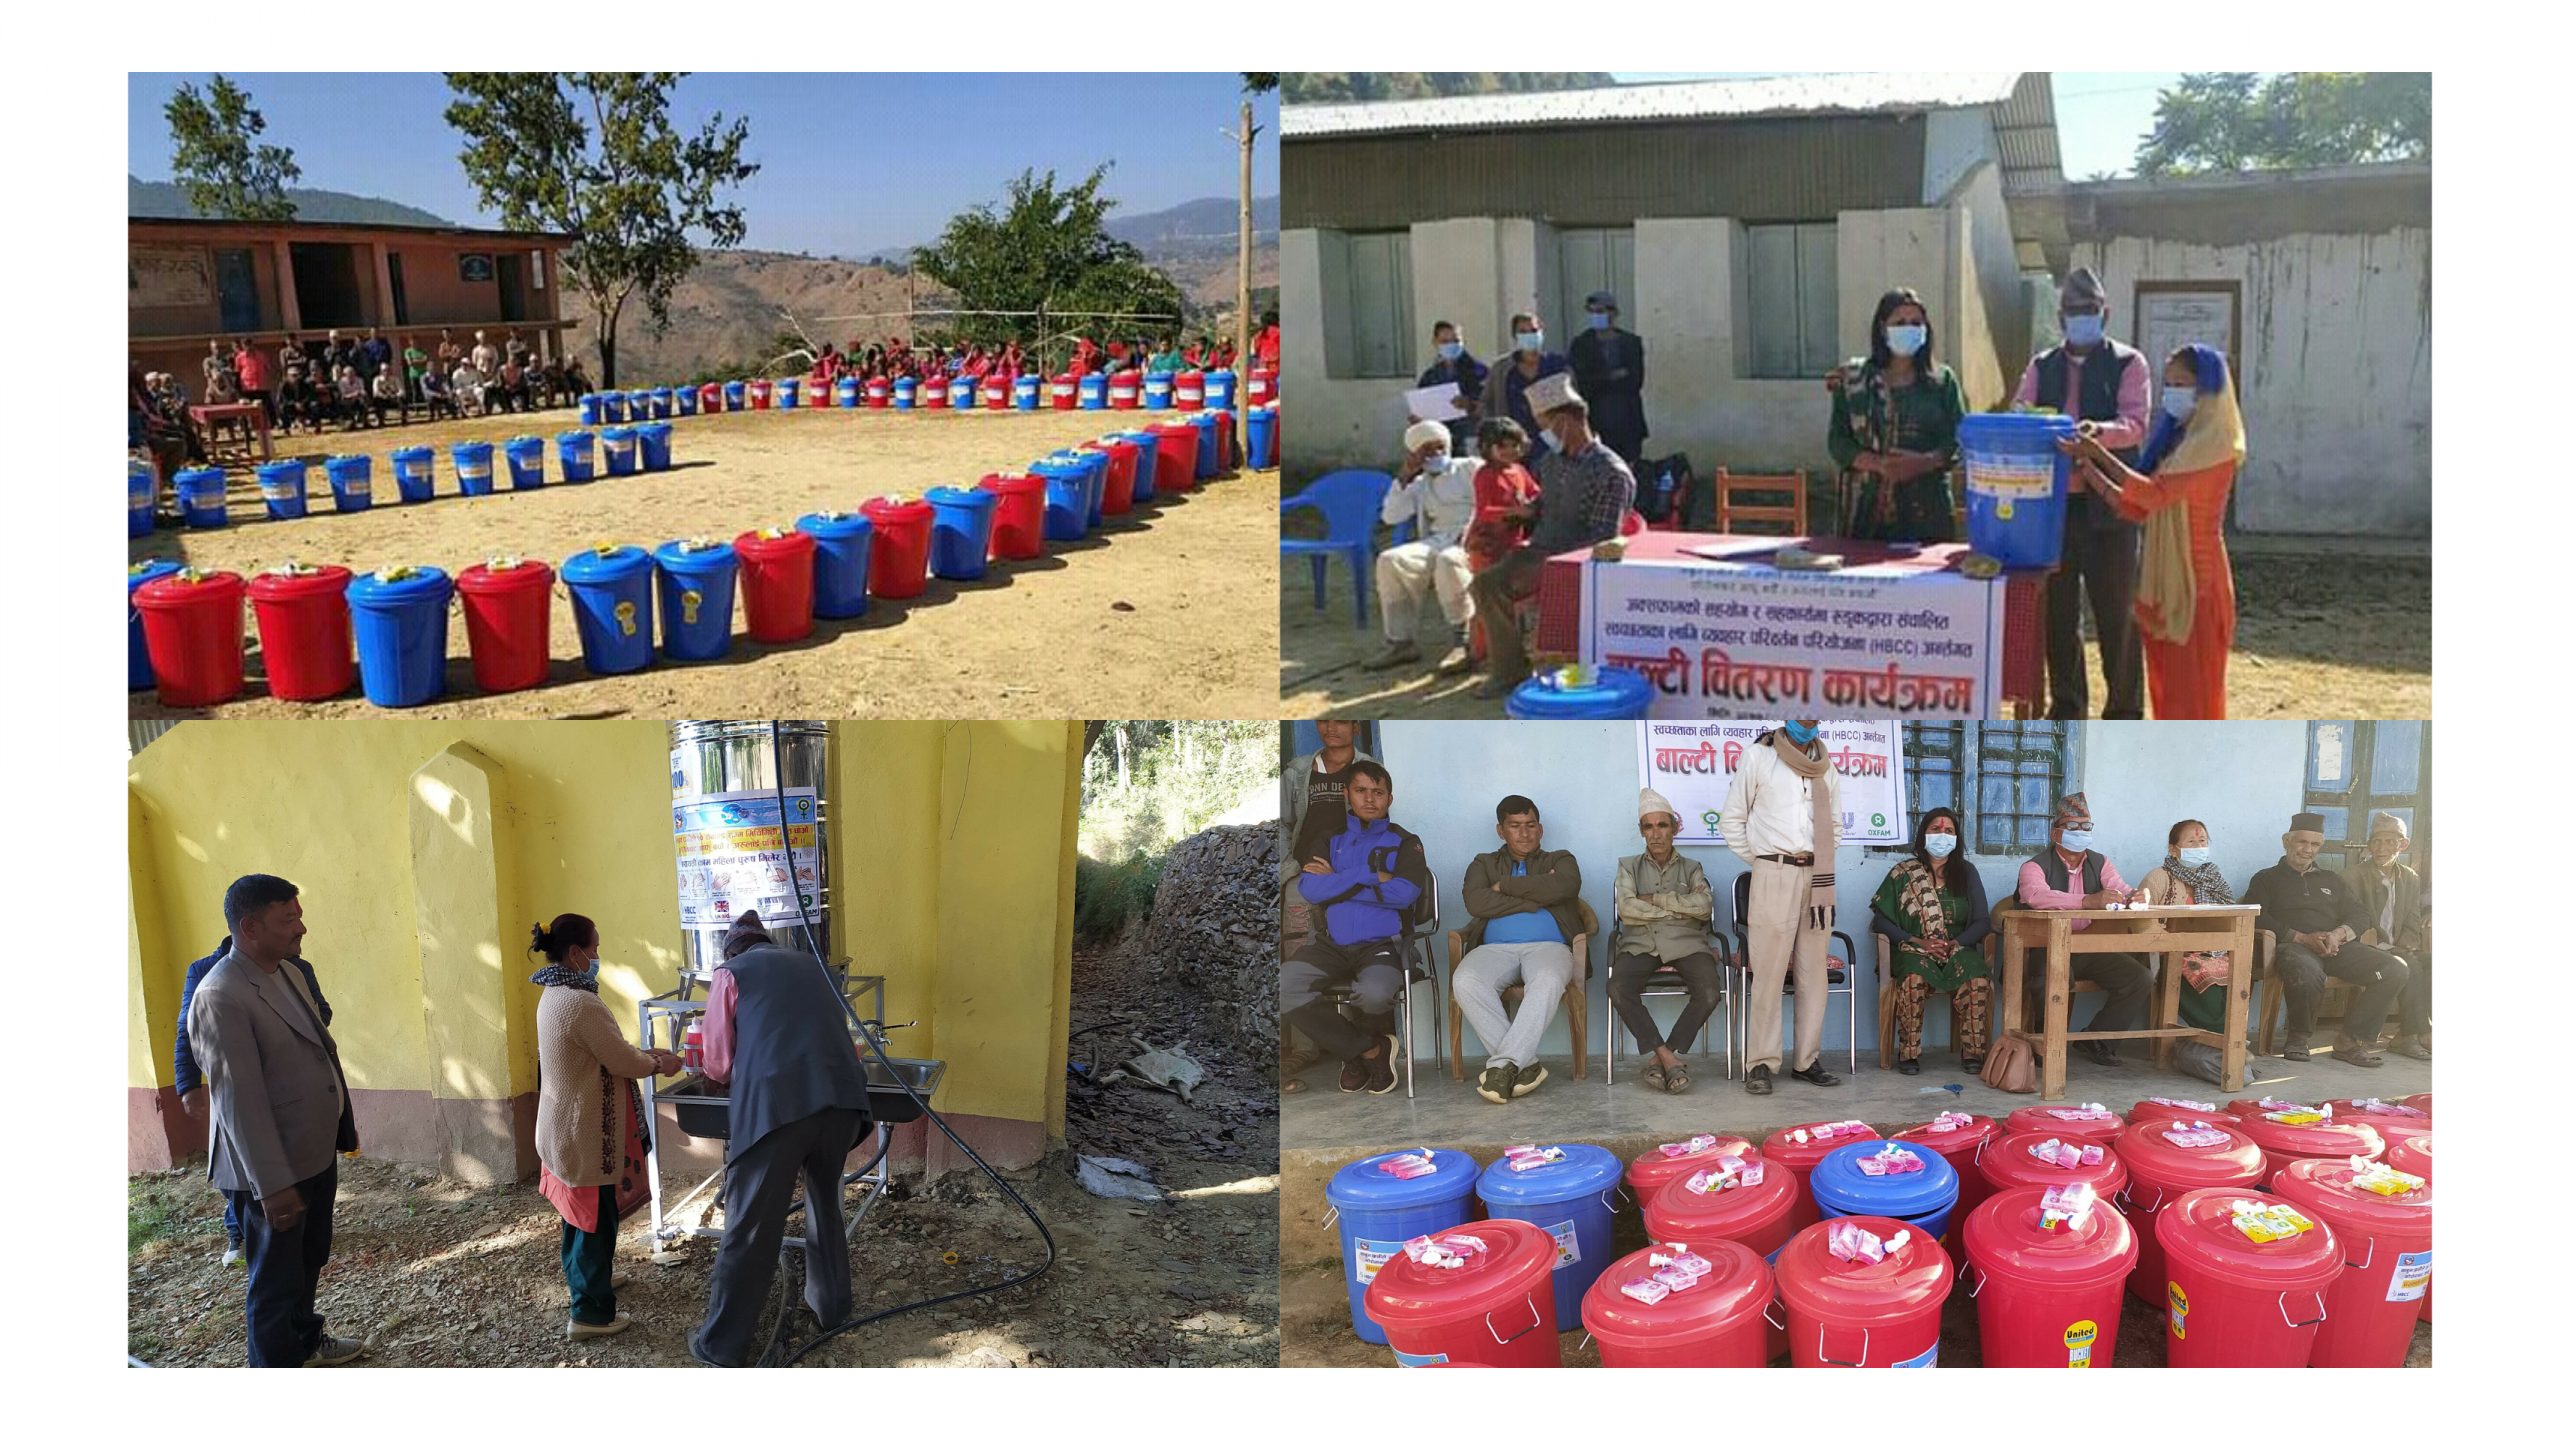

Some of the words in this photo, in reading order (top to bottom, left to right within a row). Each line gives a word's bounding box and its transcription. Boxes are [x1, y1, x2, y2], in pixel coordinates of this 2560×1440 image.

[1752, 604, 1762, 619] र
[1870, 637, 1919, 655] (HBCC)
[1701, 646, 1813, 704] वितरण
[1821, 662, 1975, 715] कार्यक्रम
[1653, 724, 1698, 736] स्वच्छताका
[1699, 724, 1721, 737] लागि
[1723, 726, 1753, 738] व्यवहार
[1832, 730, 1861, 742] (HBCC)
[1655, 741, 1717, 775] बाल्टी
[2066, 1326, 2095, 1339] United
